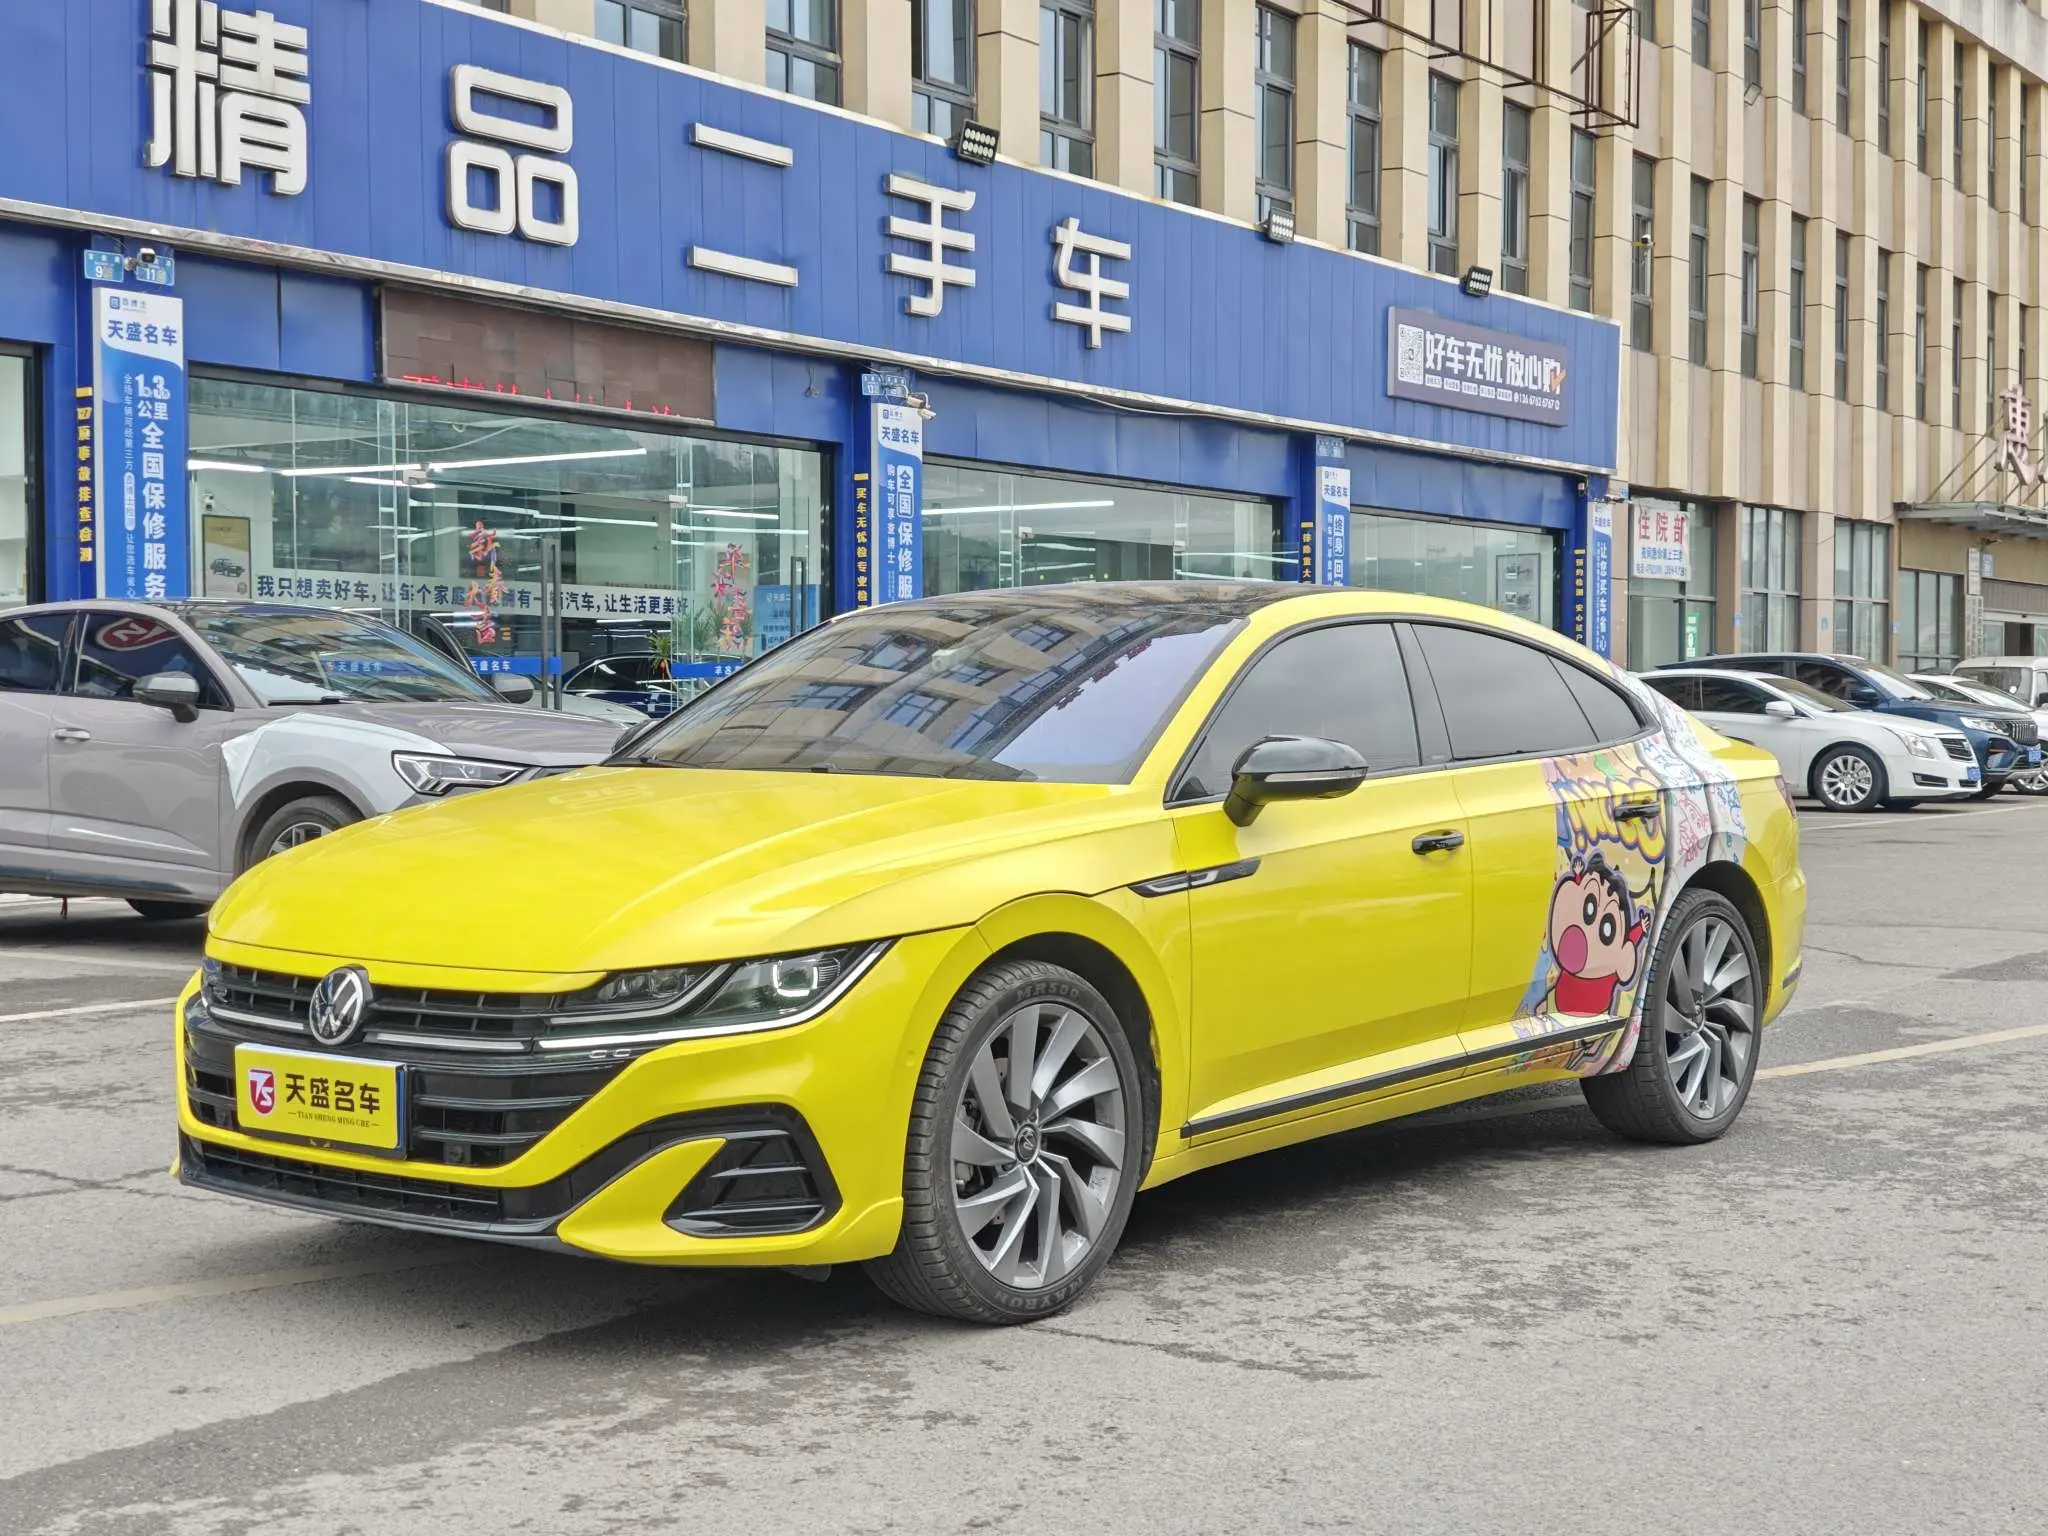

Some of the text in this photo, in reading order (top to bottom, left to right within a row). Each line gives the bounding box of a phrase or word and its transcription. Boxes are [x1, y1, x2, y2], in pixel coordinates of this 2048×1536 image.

[143, 0, 1132, 349] 精品二手车
[108, 319, 178, 346] 天盛名车
[1425, 331, 1503, 383] 好车无忧
[1506, 349, 1561, 395] 放心购
[137, 400, 169, 421] 公里
[881, 426, 920, 445] 天盛名车
[1324, 484, 1348, 497] 天盛名车
[141, 422, 167, 600] 全国保修服务
[1639, 511, 1684, 545] 住院部
[285, 1073, 381, 1115] 天盛名车
